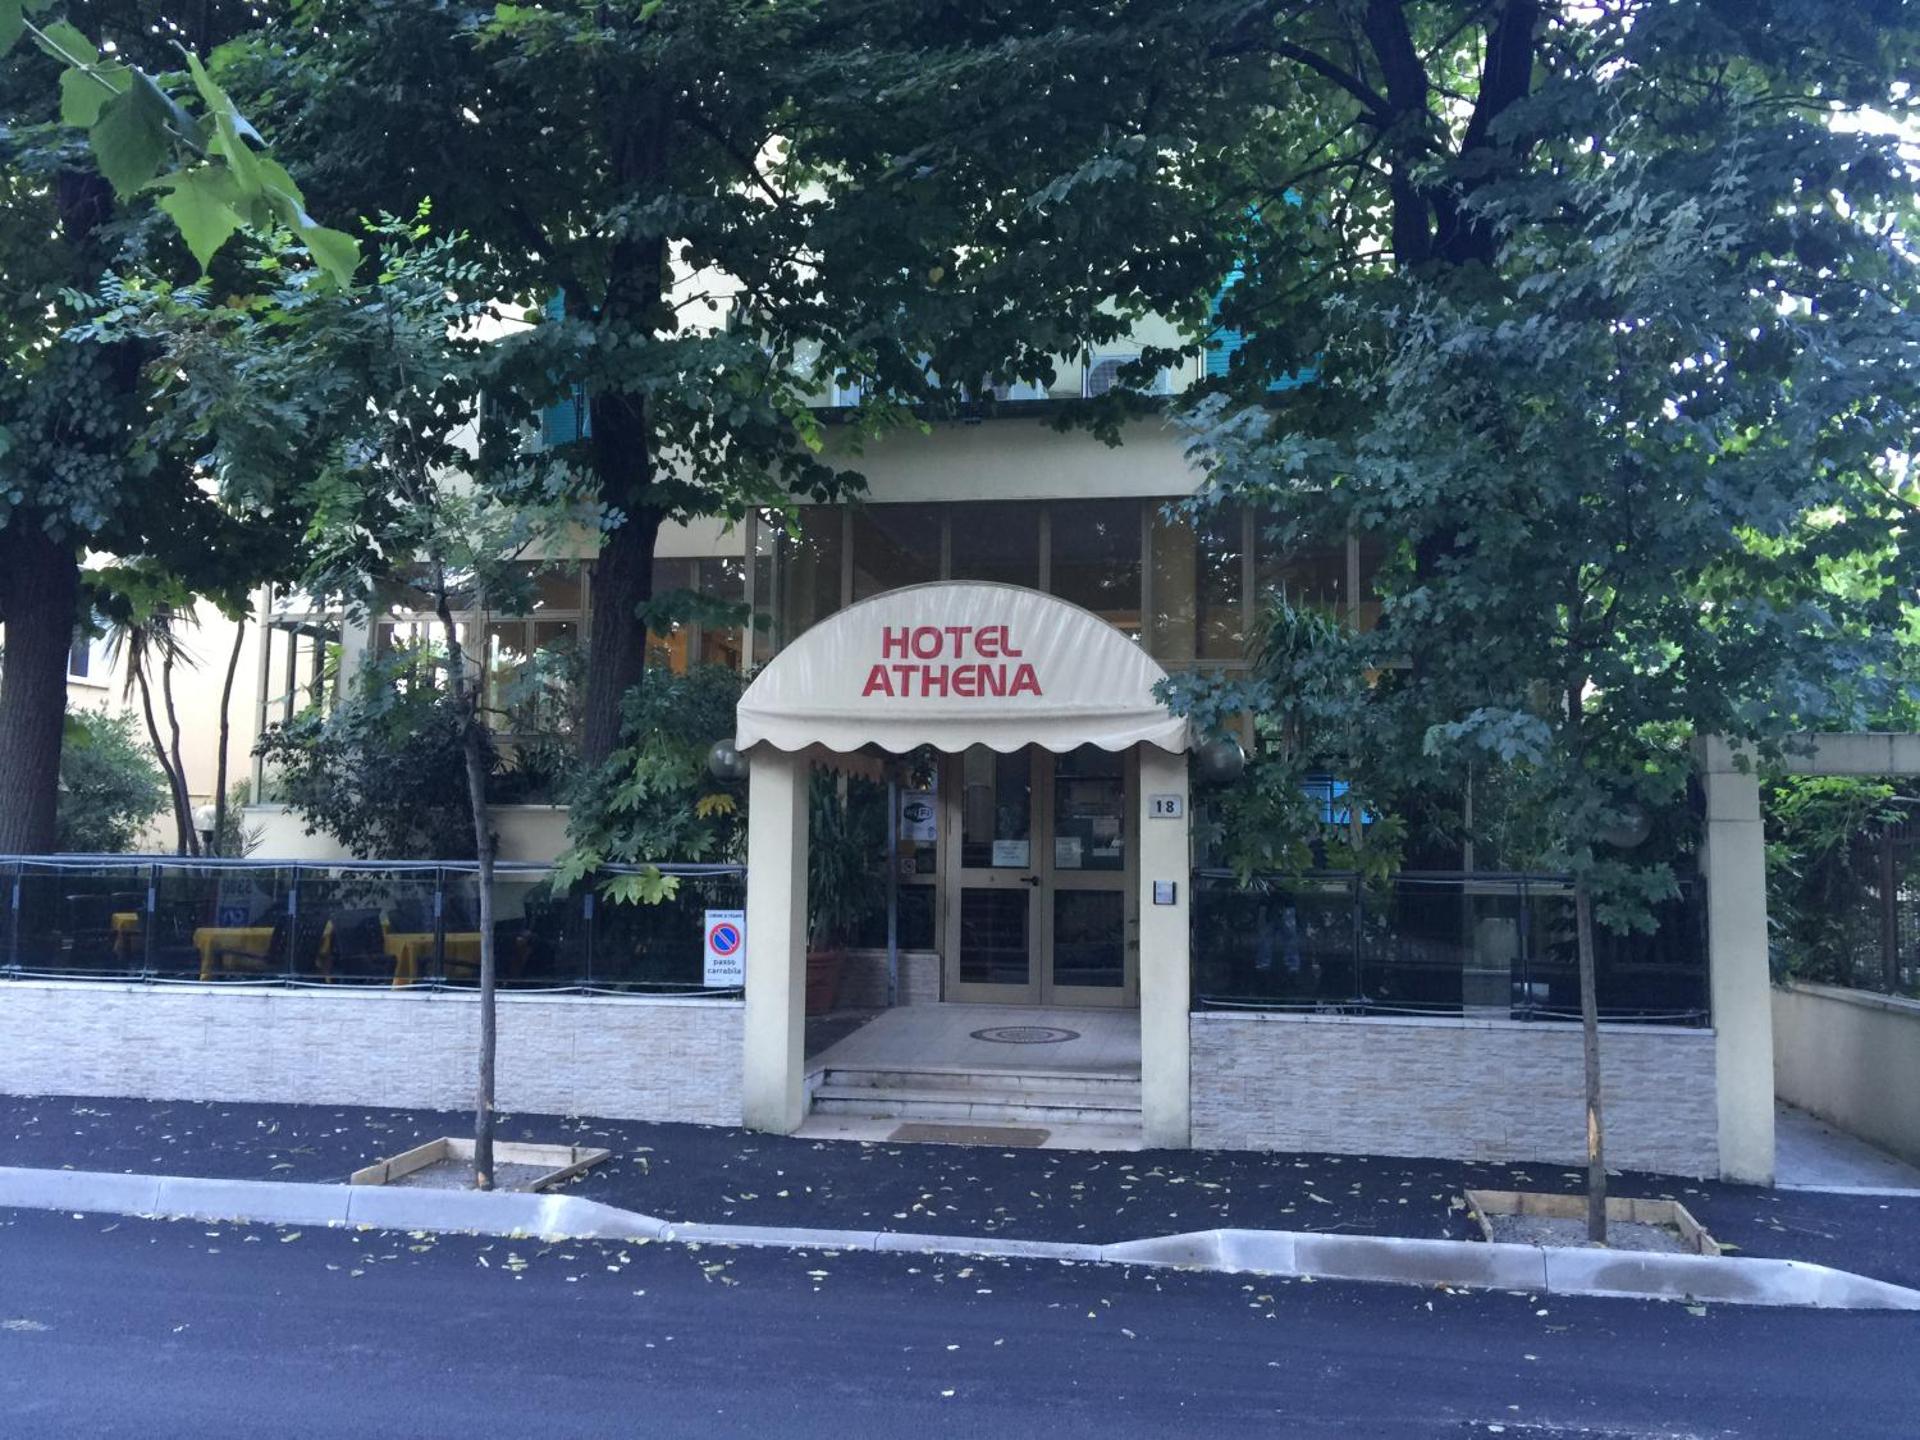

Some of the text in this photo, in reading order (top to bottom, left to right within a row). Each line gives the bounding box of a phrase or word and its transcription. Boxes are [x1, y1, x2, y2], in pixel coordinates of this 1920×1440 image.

[882, 625, 1023, 660] HOTEL
[861, 664, 1043, 697] ATHENA
[1156, 800, 1174, 813] 18
